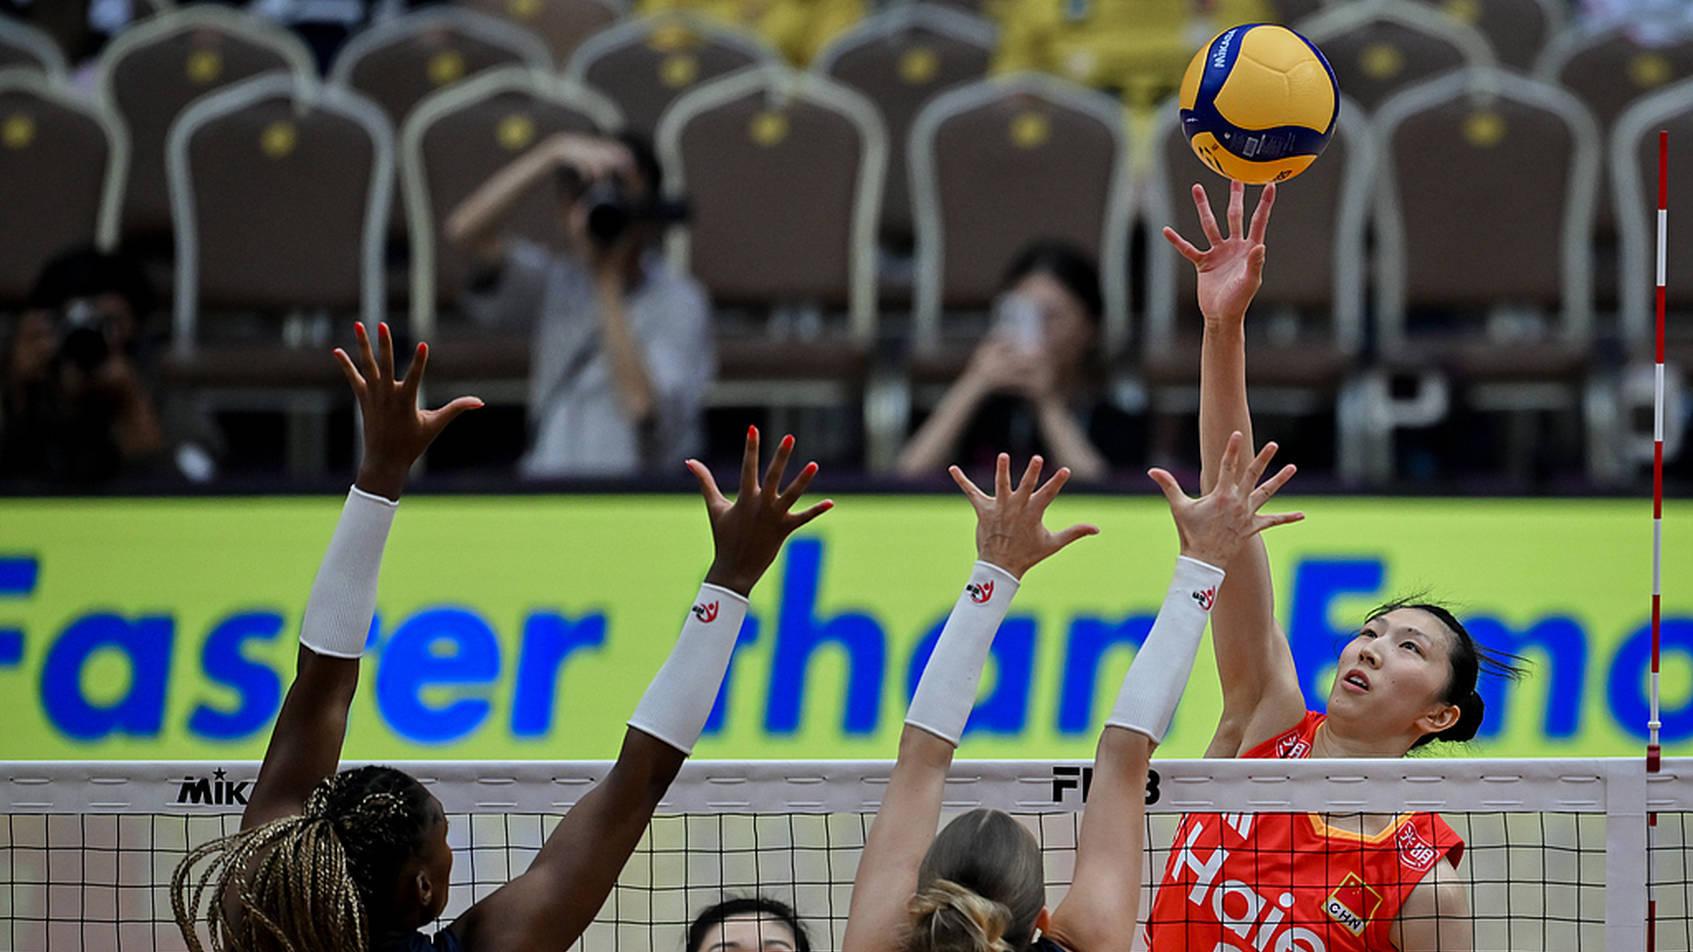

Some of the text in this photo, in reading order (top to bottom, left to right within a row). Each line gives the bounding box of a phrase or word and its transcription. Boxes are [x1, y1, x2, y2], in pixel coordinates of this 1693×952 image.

[0, 554, 608, 743] aser
[1052, 766, 1160, 805] FIB
[1329, 902, 1362, 930] CHN
